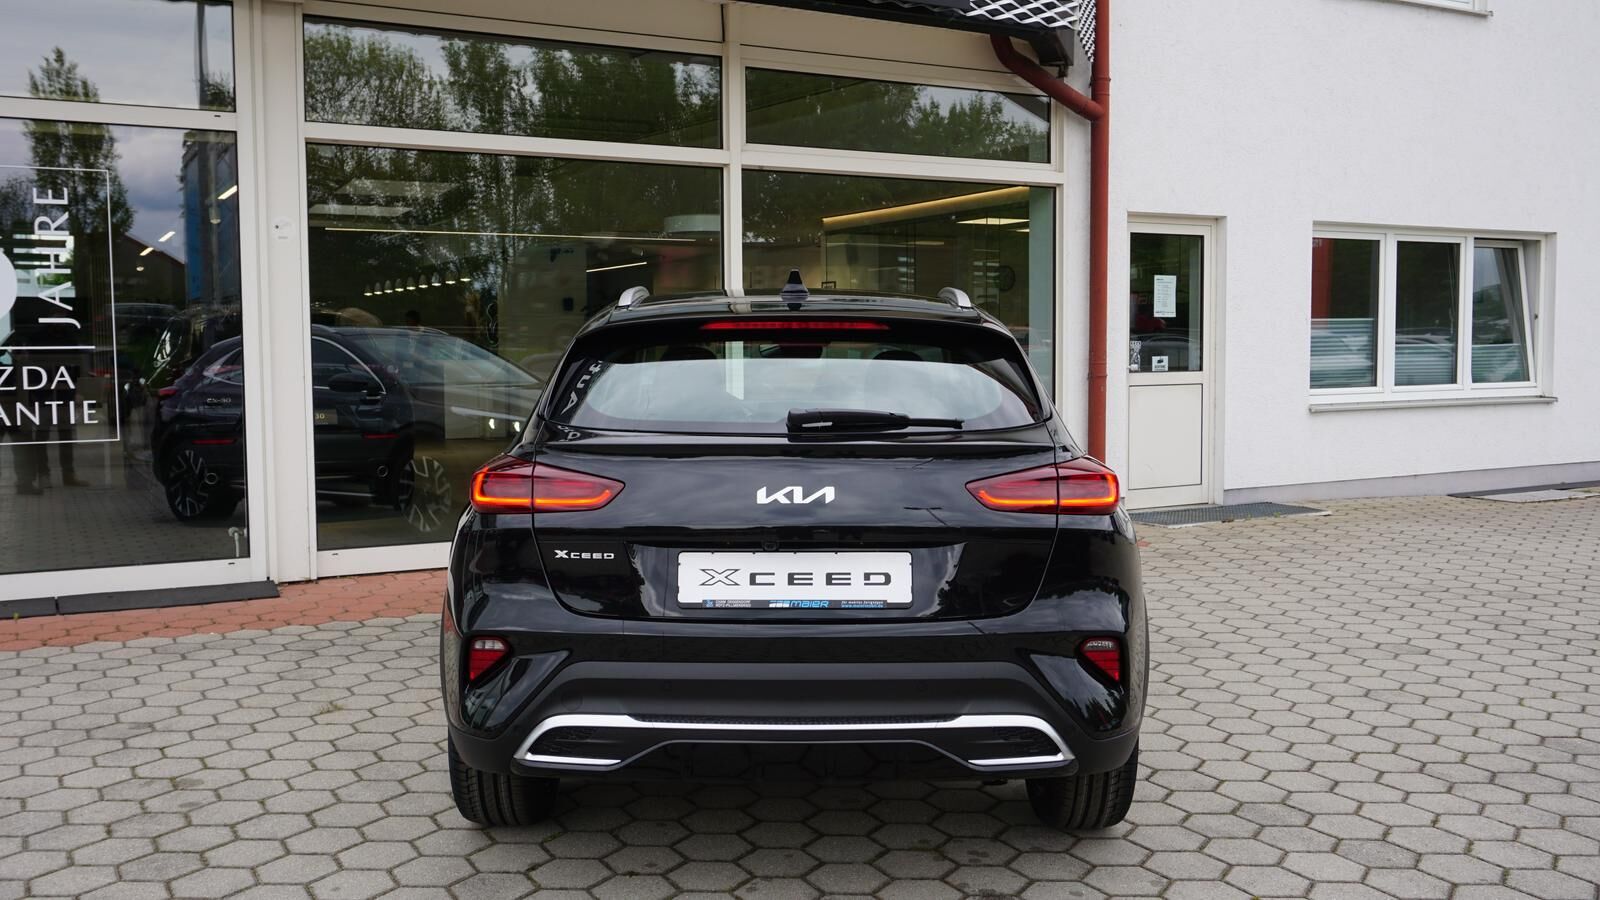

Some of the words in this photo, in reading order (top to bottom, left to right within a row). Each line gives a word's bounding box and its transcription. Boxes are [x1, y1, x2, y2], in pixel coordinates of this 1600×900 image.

[33, 187, 81, 329] JAHRE
[0, 366, 76, 391] ZDA
[756, 486, 835, 504] KIA
[554, 549, 615, 560] XCEED
[700, 569, 892, 586] XCEED
